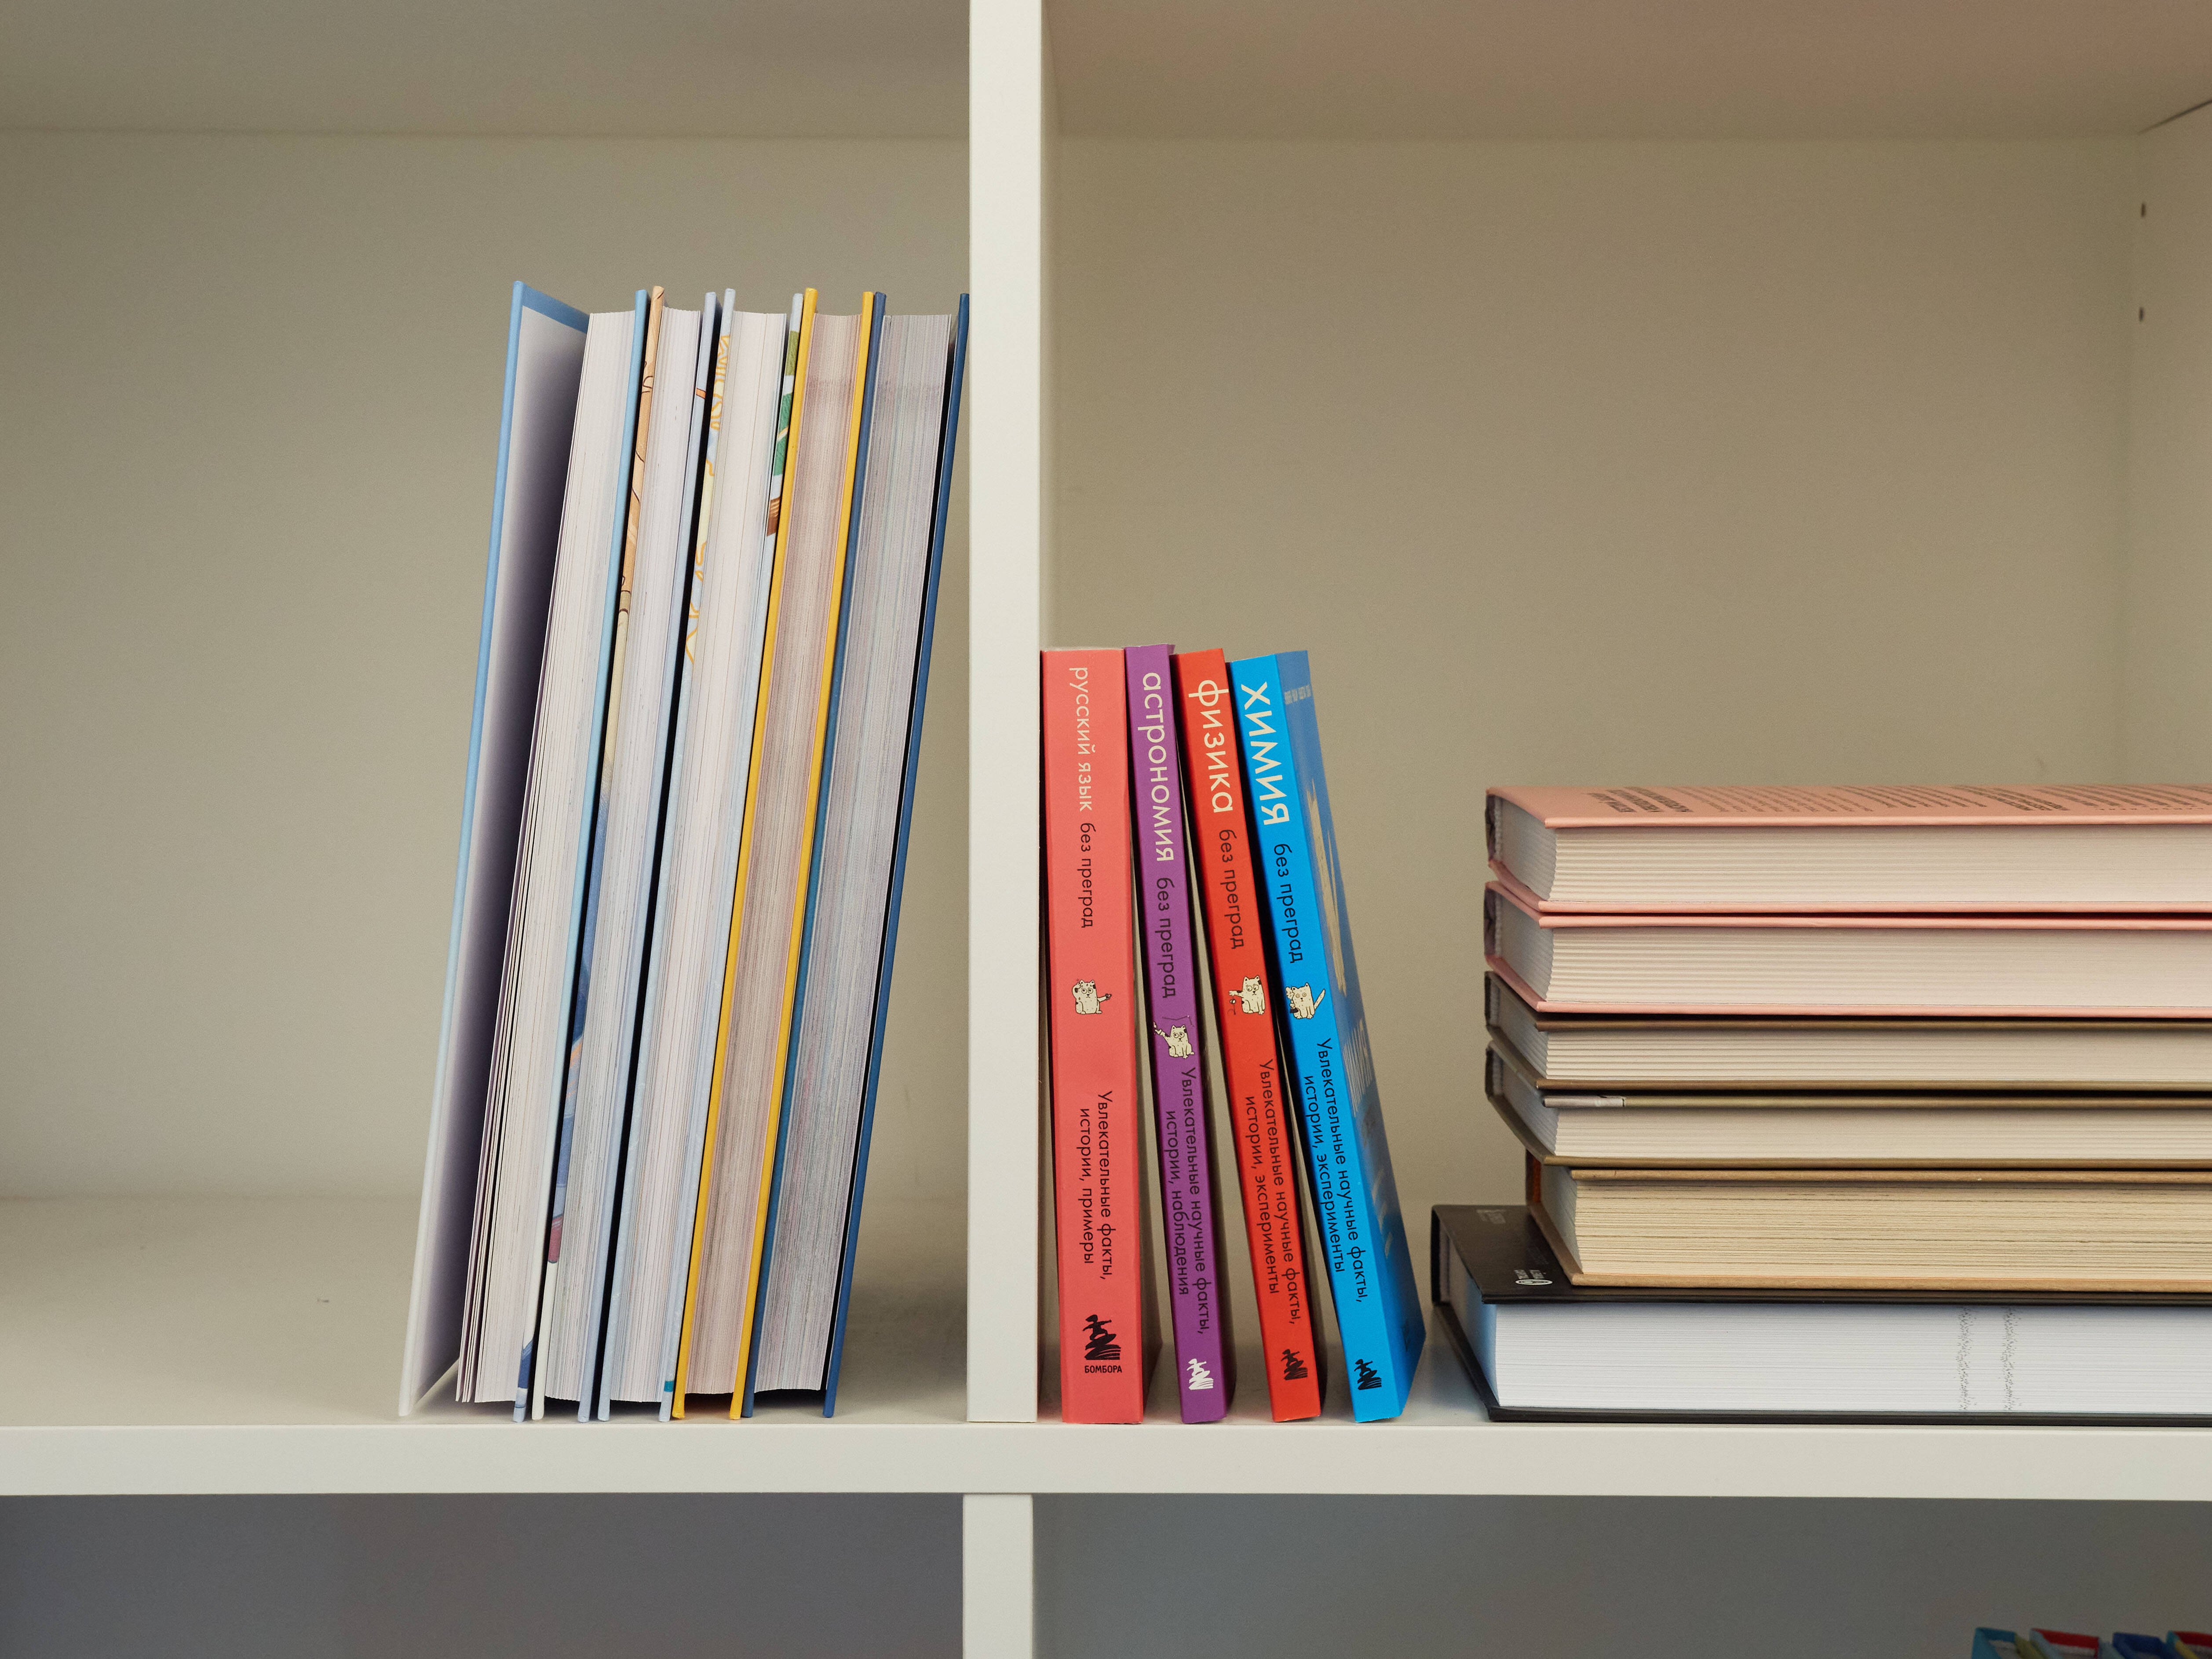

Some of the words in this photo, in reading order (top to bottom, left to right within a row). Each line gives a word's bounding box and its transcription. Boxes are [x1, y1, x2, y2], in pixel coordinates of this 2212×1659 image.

[1069, 667, 1095, 755] русский
[1189, 680, 1233, 813] физика
[1078, 763, 1092, 811] язык
[1138, 672, 1174, 861] астрономия
[1241, 681, 1290, 826] химия
[1080, 822, 1096, 852] без
[1219, 829, 1237, 863] без
[1274, 844, 1292, 877] без
[1077, 859, 1093, 928] преград
[1156, 877, 1175, 911] без
[1220, 869, 1244, 949] преград
[1277, 883, 1303, 963] преград
[1155, 917, 1175, 998] преград
[1182, 1067, 1200, 1195] Увлекательные
[1259, 1059, 1284, 1186] Увлекательные
[1317, 1038, 1346, 1164] Увлекательные
[1077, 1109, 1092, 1181] истории,
[1098, 1091, 1113, 1217] Увлекательные
[1164, 1111, 1181, 1184] истории,
[1304, 1075, 1324, 1148] истории,
[1317, 1154, 1344, 1272] эксперименты
[1078, 1188, 1094, 1264] примеры
[1245, 1096, 1263, 1169] истории,
[1255, 1175, 1279, 1294] эксперименты
[1274, 1191, 1293, 1262] научные
[1337, 1170, 1358, 1240] научные
[1097, 1224, 1116, 1279] факты,
[1172, 1191, 1189, 1295] наблюдения
[1188, 1201, 1205, 1272] научные
[1192, 1277, 1211, 1334] факты,
[1281, 1268, 1300, 1324] факты,
[1347, 1246, 1368, 1303] факты,
